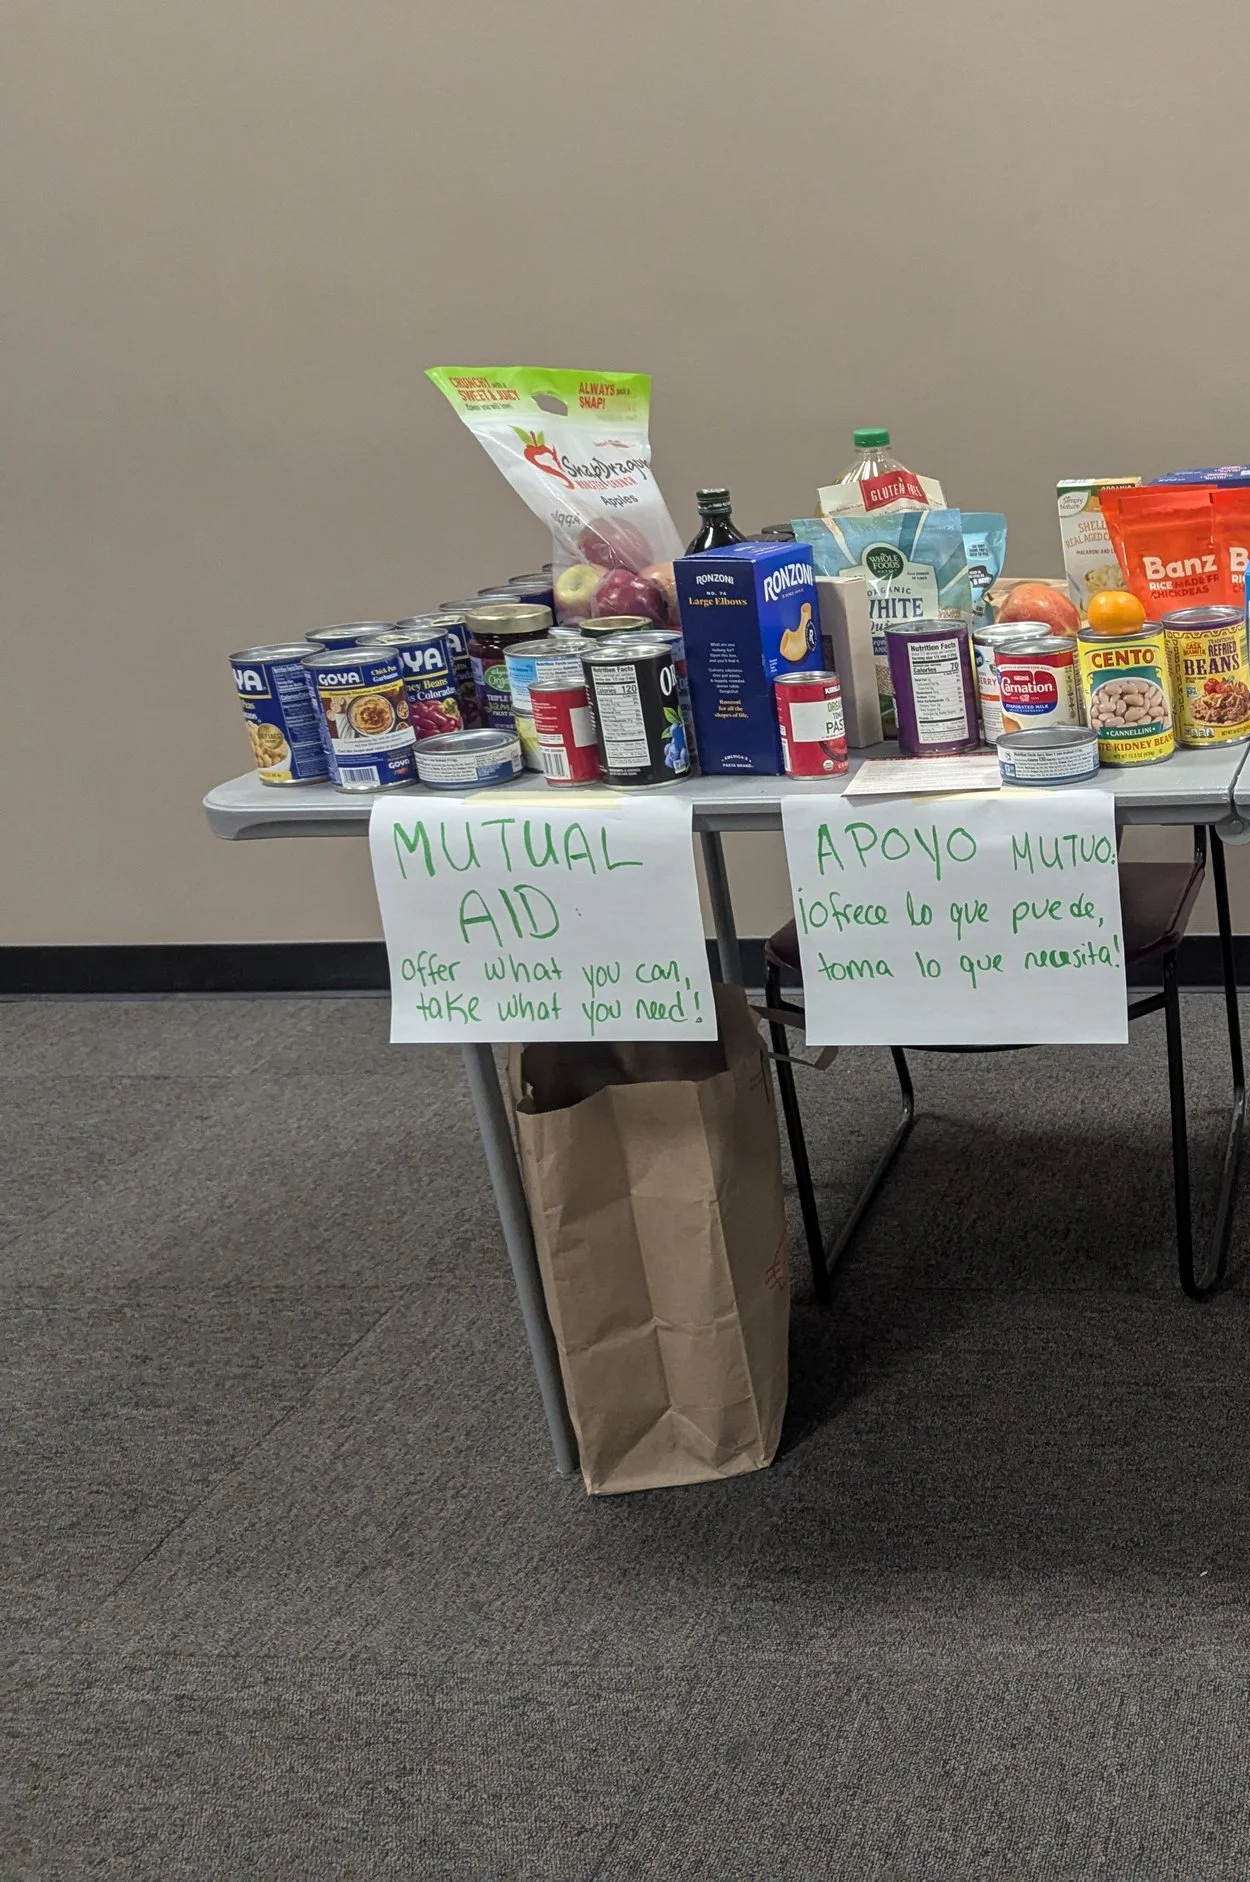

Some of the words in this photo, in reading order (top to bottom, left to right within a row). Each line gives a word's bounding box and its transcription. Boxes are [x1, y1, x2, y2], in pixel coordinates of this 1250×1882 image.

[449, 377, 491, 388] CRUNCHY
[579, 382, 616, 396] ALWAYS
[458, 390, 490, 401] SWEET
[579, 396, 606, 409] SNAP!
[871, 483, 905, 502] GLUTEN
[906, 483, 923, 497] FREE
[600, 494, 639, 508] Apples
[1084, 532, 1103, 543] AGED
[869, 553, 899, 563] WHOLE
[873, 561, 900, 571] FOODS
[696, 574, 734, 585] RONZONI
[764, 562, 813, 602] RONZONI
[1149, 580, 1174, 591] RICE
[1174, 575, 1205, 588] MADE
[1151, 586, 1210, 600] CHICKPEAS
[688, 597, 714, 608] Large
[714, 597, 748, 606] Elbows
[940, 642, 956, 650] Facts
[1208, 641, 1237, 657] REFRIED
[1091, 648, 1155, 669] CENTO
[1183, 653, 1240, 676] BEANS
[950, 661, 960, 671] 70
[318, 672, 361, 686] GOYA
[422, 678, 449, 690] Beans
[596, 687, 617, 695] Calories
[621, 684, 638, 694] 120
[1001, 677, 1053, 696] Carnation
[1110, 726, 1152, 737] CANNELLINI
[1114, 740, 1152, 752] KIDNEY
[387, 758, 411, 769] GOYA
[393, 818, 643, 879] MUTUAL
[817, 823, 977, 881] APOYO
[1011, 831, 1117, 874] MUTUO:
[906, 891, 933, 926] lo
[950, 898, 990, 941] que
[818, 952, 895, 981] toma
[915, 951, 942, 978] lo
[960, 951, 1004, 990] que
[1024, 934, 1121, 970] necesita!
[484, 953, 563, 983] what
[582, 960, 621, 999] you
[636, 959, 691, 990] can,
[416, 990, 483, 1025] take
[499, 991, 562, 1022] what
[582, 1001, 622, 1036] you
[636, 990, 704, 1024] need!
